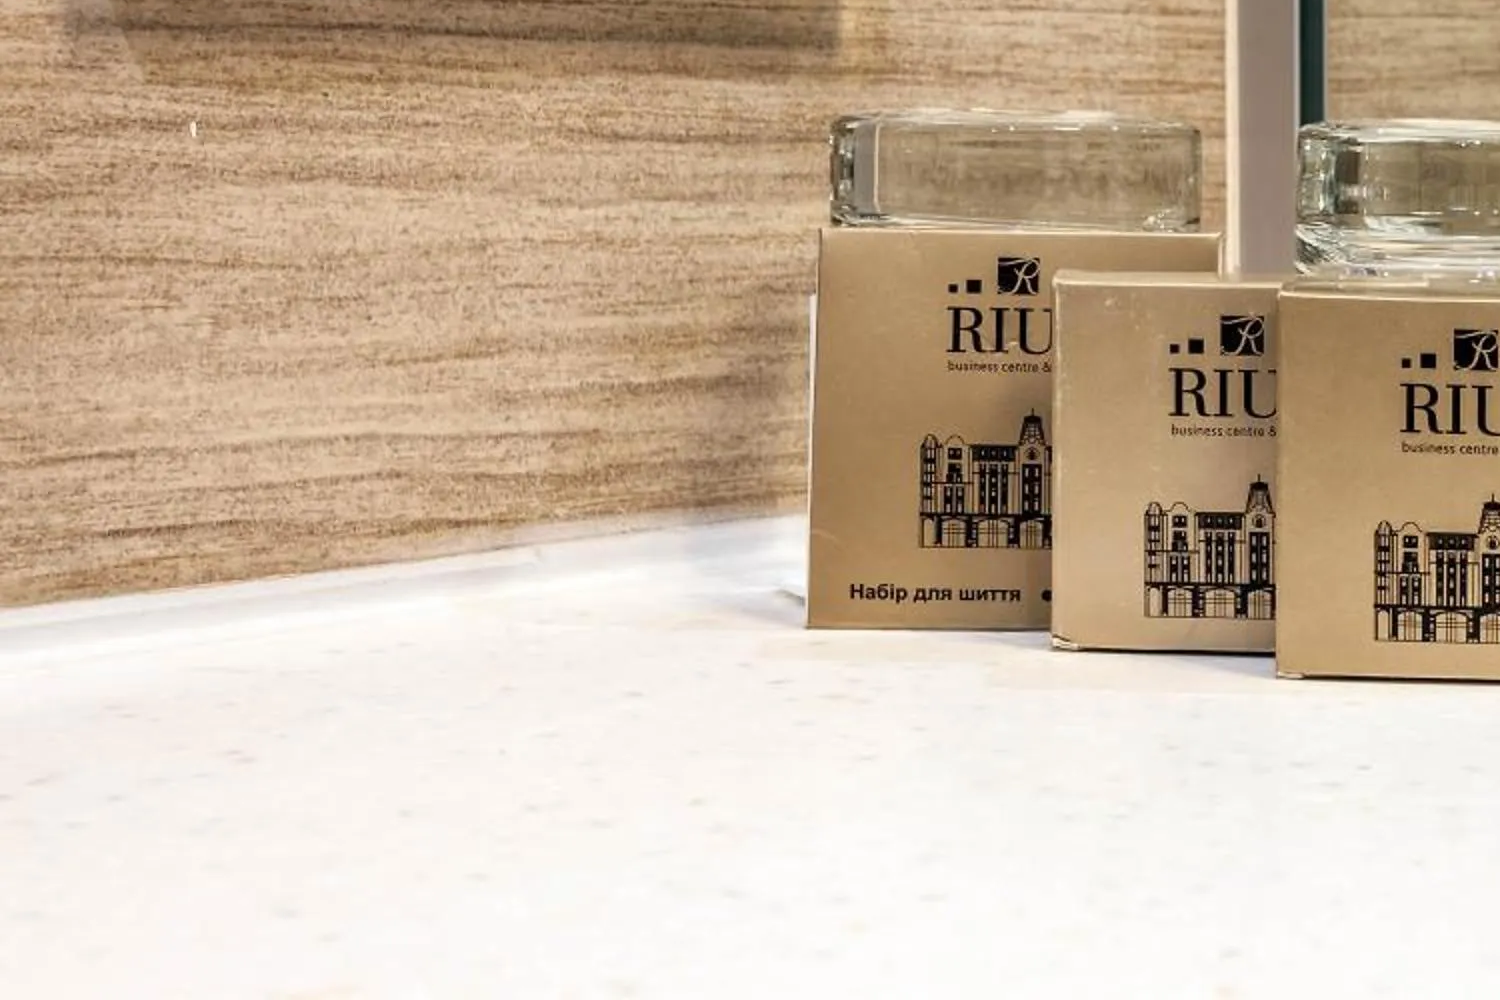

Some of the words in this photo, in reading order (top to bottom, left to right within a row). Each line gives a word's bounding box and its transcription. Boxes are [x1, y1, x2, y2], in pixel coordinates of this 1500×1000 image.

[945, 305, 1053, 355] RIU
[947, 361, 999, 373] business
[1001, 362, 1040, 373] centre
[1167, 367, 1277, 419] RIU
[1171, 424, 1224, 437] business
[1226, 426, 1265, 437] centre
[1401, 441, 1457, 455] business
[1459, 444, 1500, 455] centre
[849, 583, 908, 605] Набір
[912, 588, 953, 603] для
[958, 588, 1022, 602] шиття
